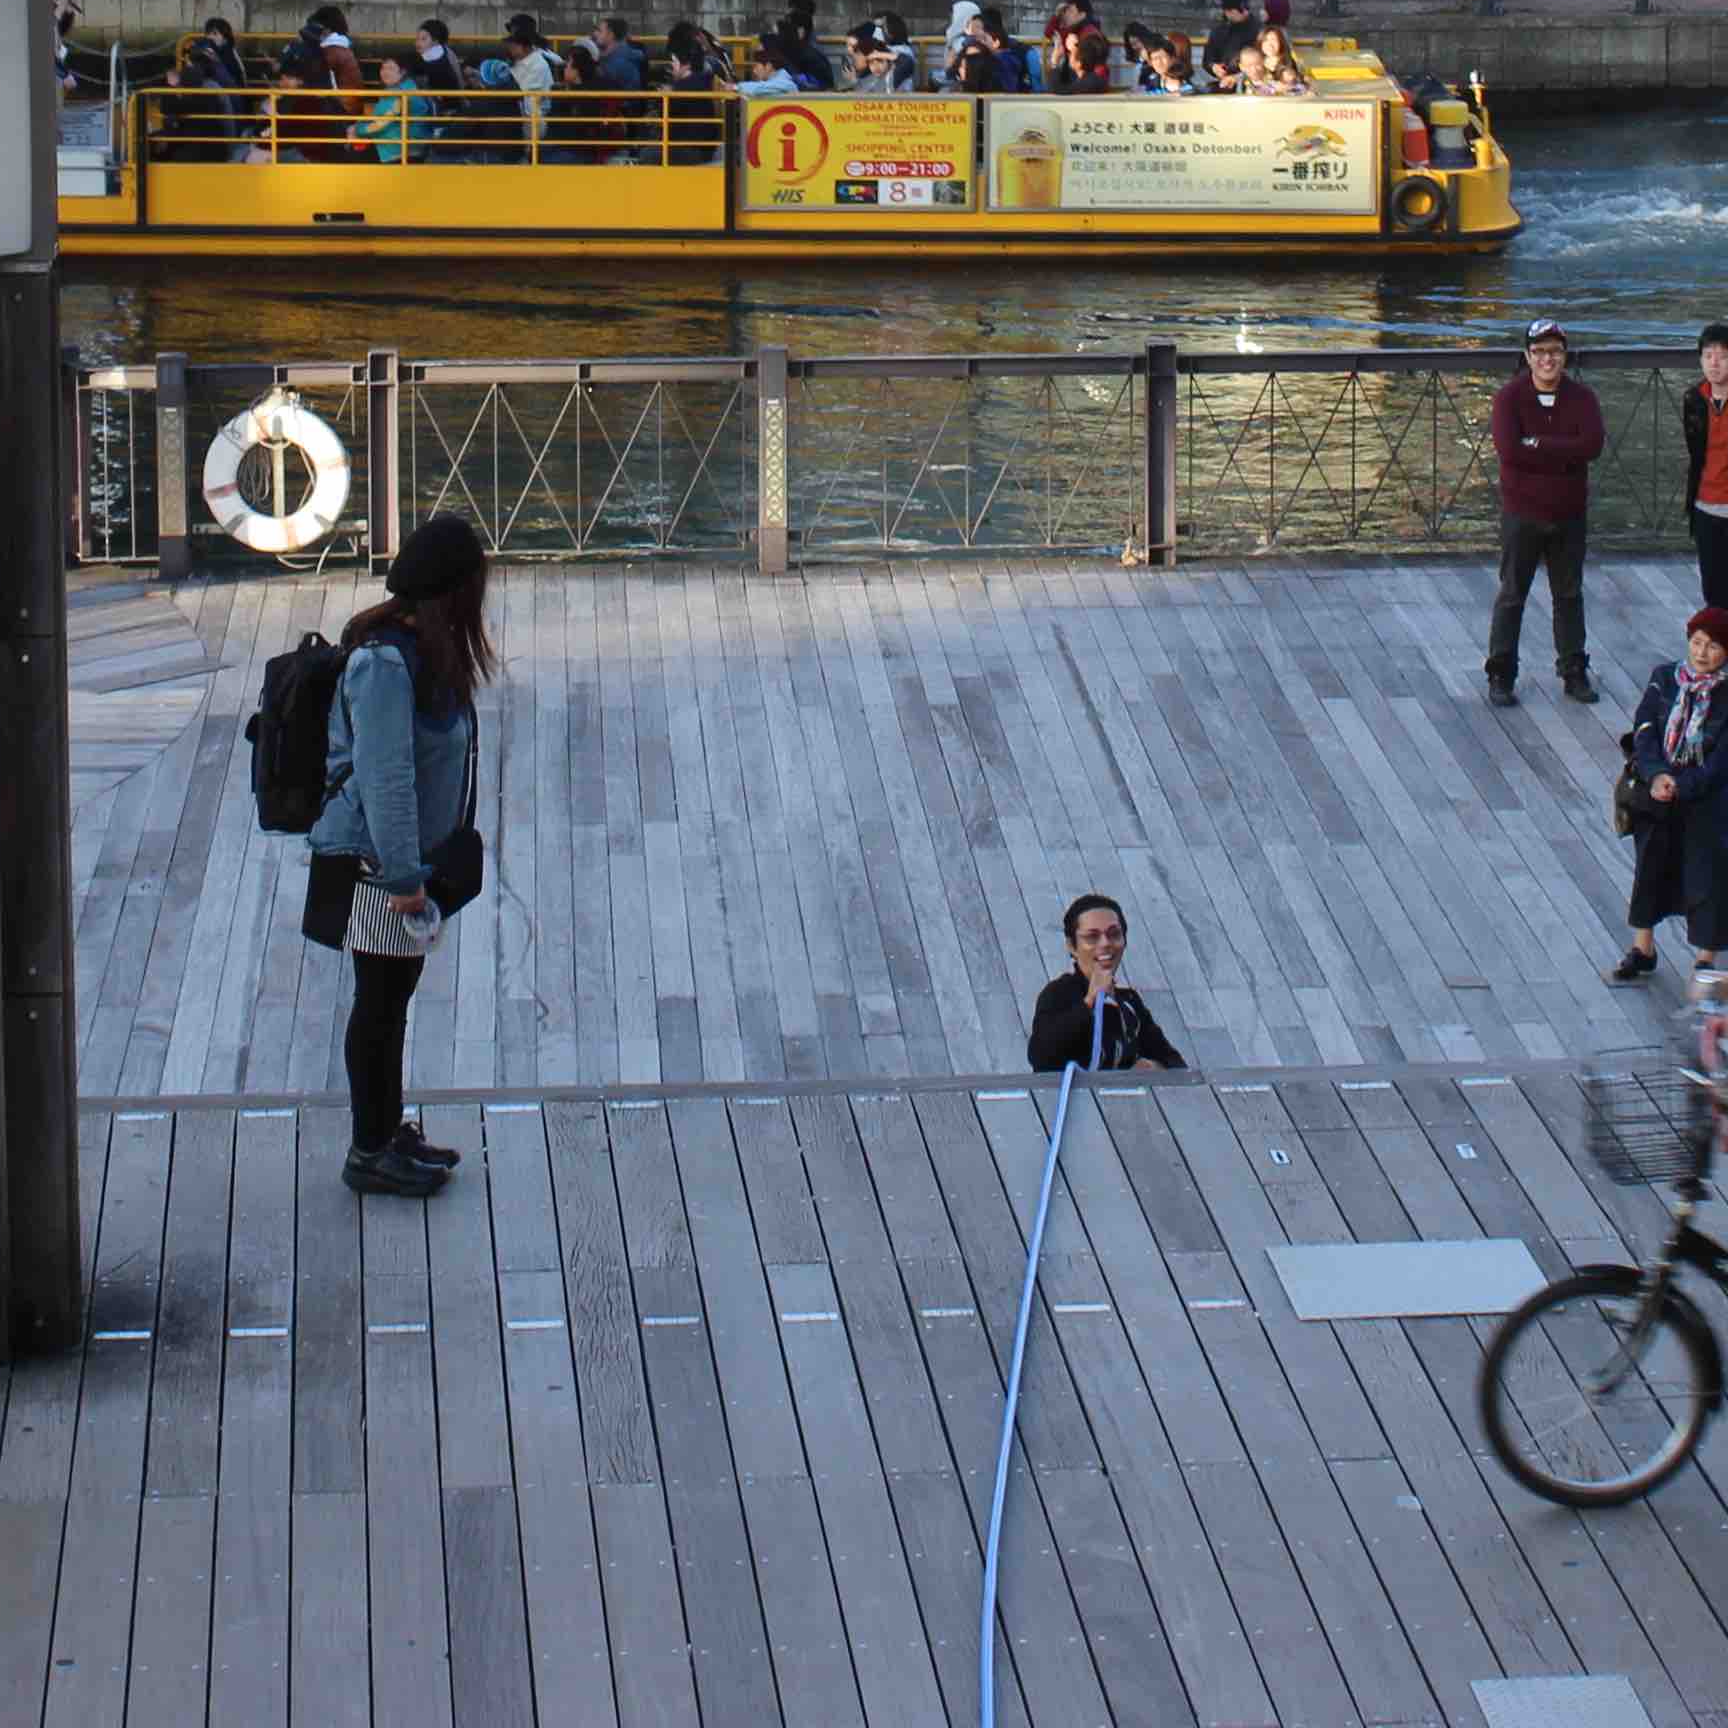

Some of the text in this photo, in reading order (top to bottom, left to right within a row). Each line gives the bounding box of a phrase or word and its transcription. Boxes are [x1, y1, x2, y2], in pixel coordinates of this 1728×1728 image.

[1324, 109, 1366, 120] KIRIN
[1143, 143, 1186, 153] Osaka
[1192, 143, 1263, 154] Dotonbori
[1272, 161, 1349, 181] 一番搾り
